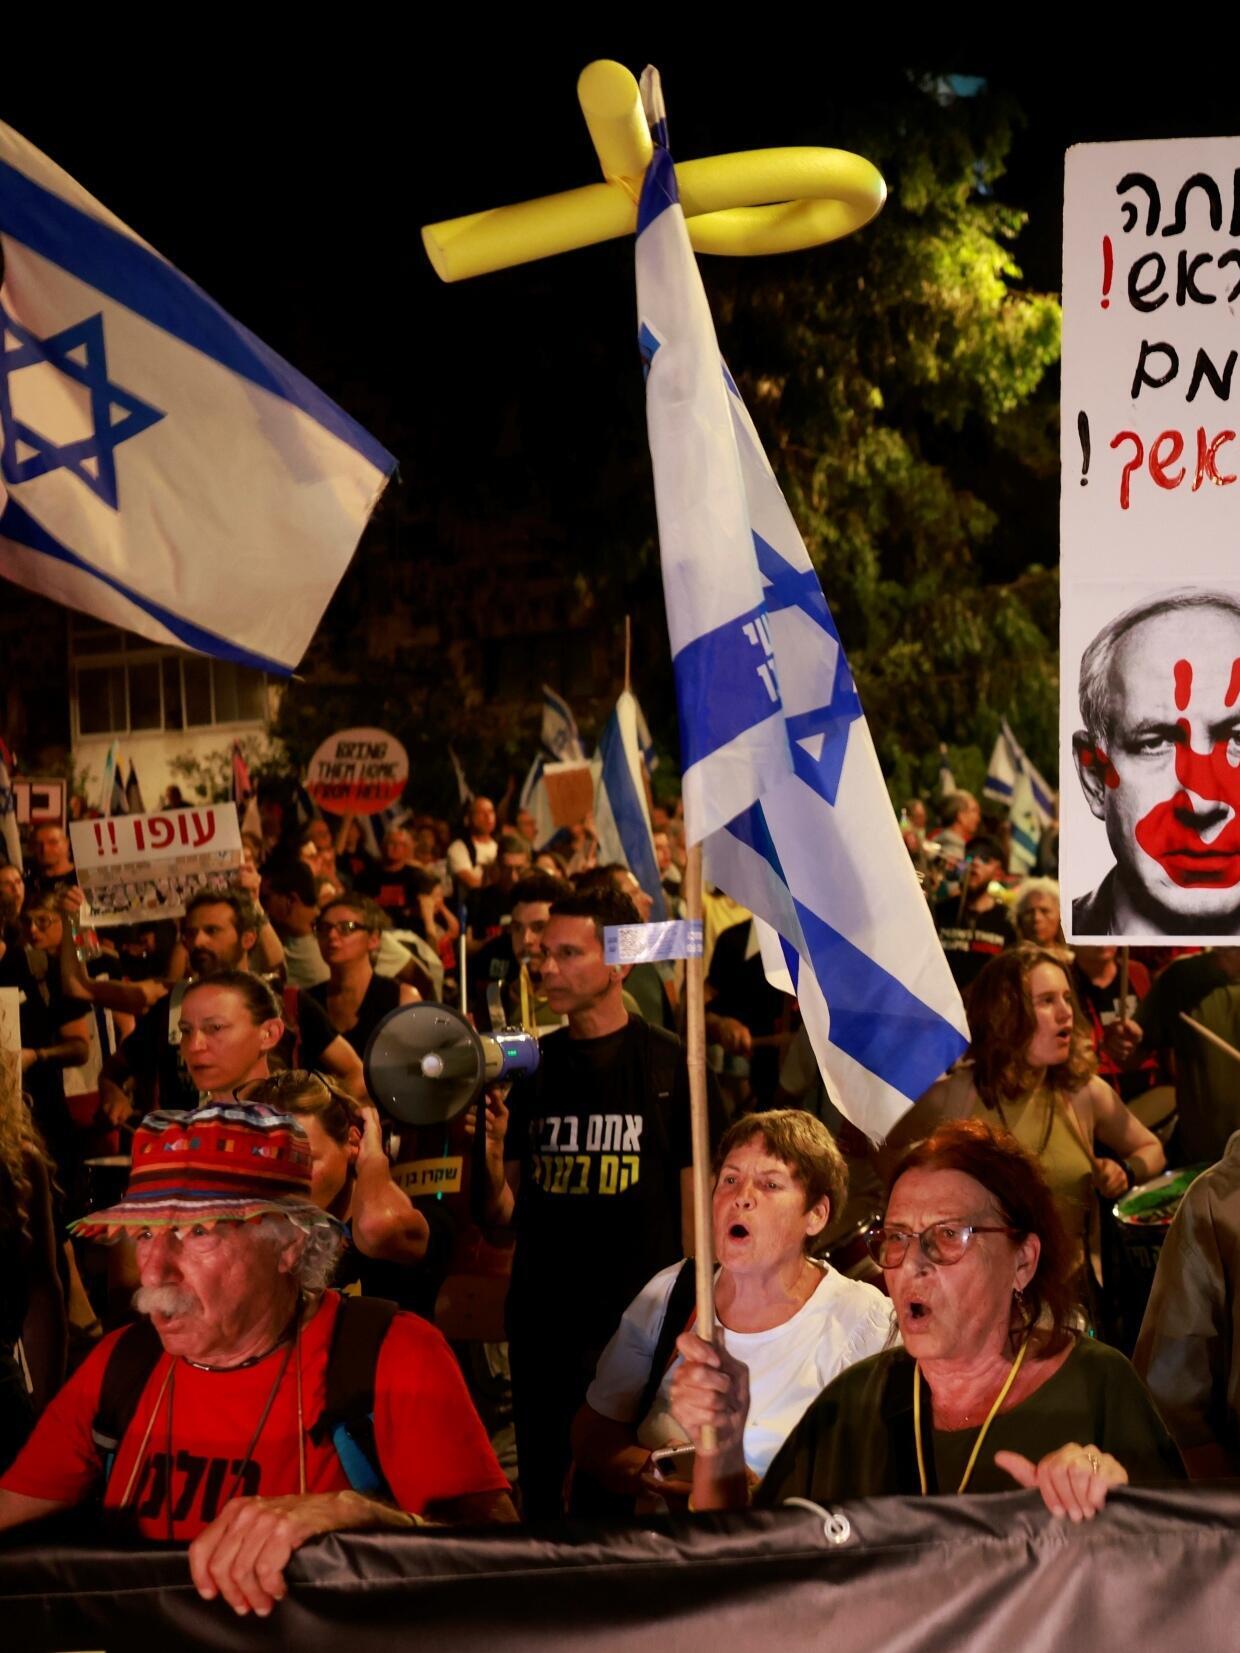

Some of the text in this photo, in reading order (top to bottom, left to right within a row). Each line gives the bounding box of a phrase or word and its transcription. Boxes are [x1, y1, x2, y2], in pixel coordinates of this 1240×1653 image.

[133, 809, 216, 852] עופו
[585, 1113, 643, 1152] אתם
[597, 1154, 640, 1195] הם
